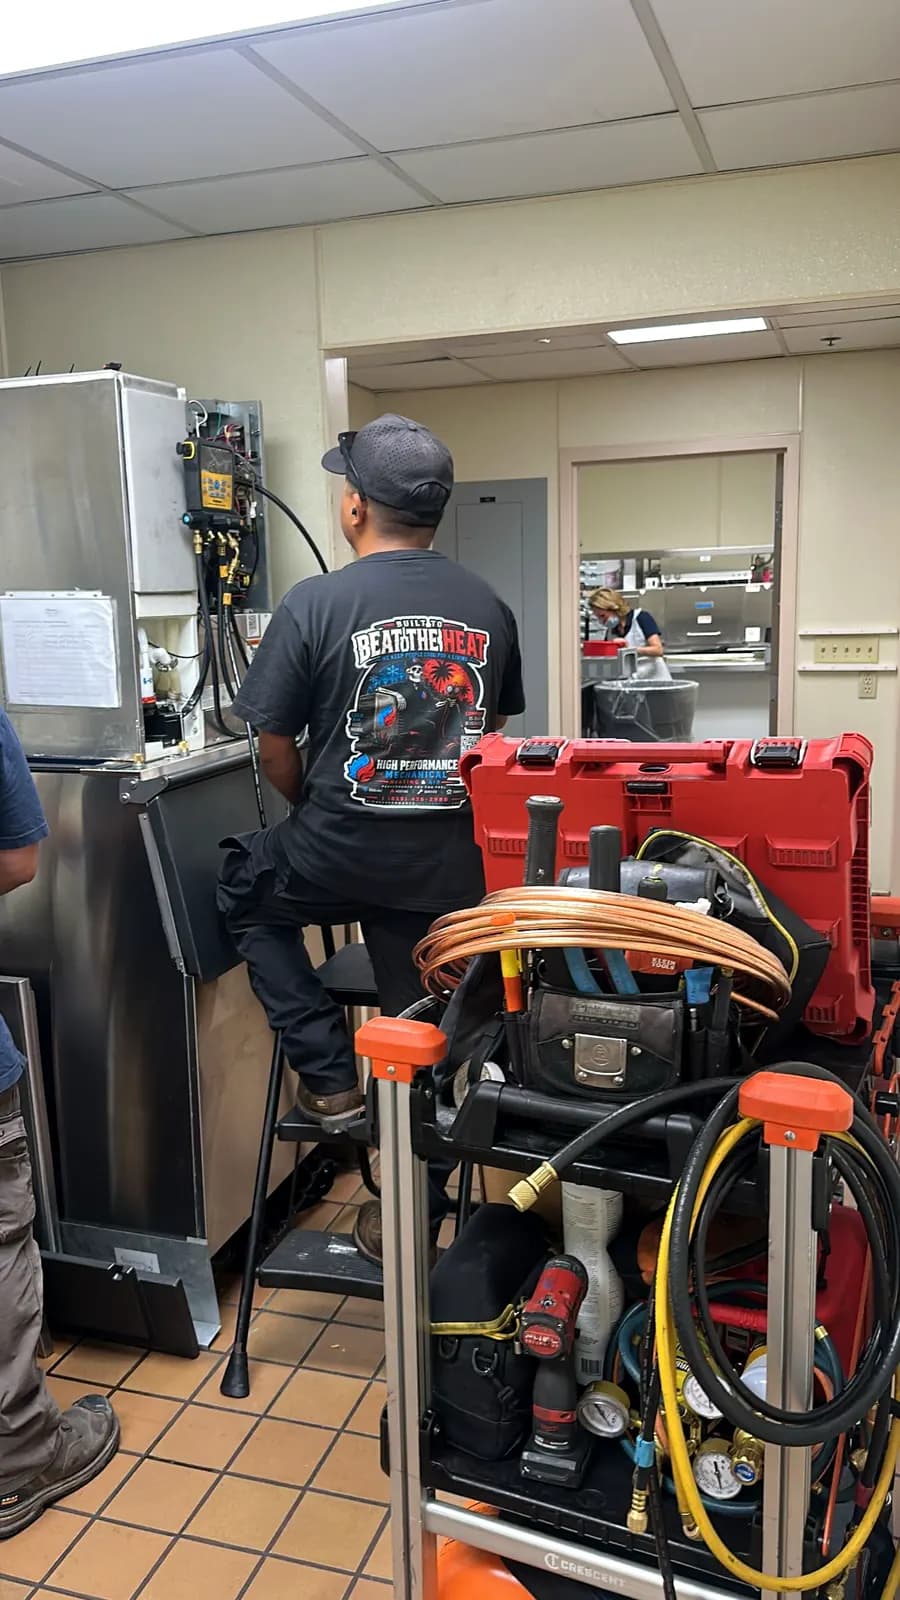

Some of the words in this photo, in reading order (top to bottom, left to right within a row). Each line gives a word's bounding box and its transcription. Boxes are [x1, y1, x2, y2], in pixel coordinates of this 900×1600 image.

[396, 620, 426, 628] BUILT
[356, 628, 402, 665] BEAT
[406, 628, 439, 652] THE
[442, 628, 485, 662] HEAT
[376, 759, 398, 770] HIGH
[400, 759, 458, 771] PERFORMANCE
[385, 771, 447, 779] MECHANICAL
[560, 1559, 625, 1587] CRESCENT
